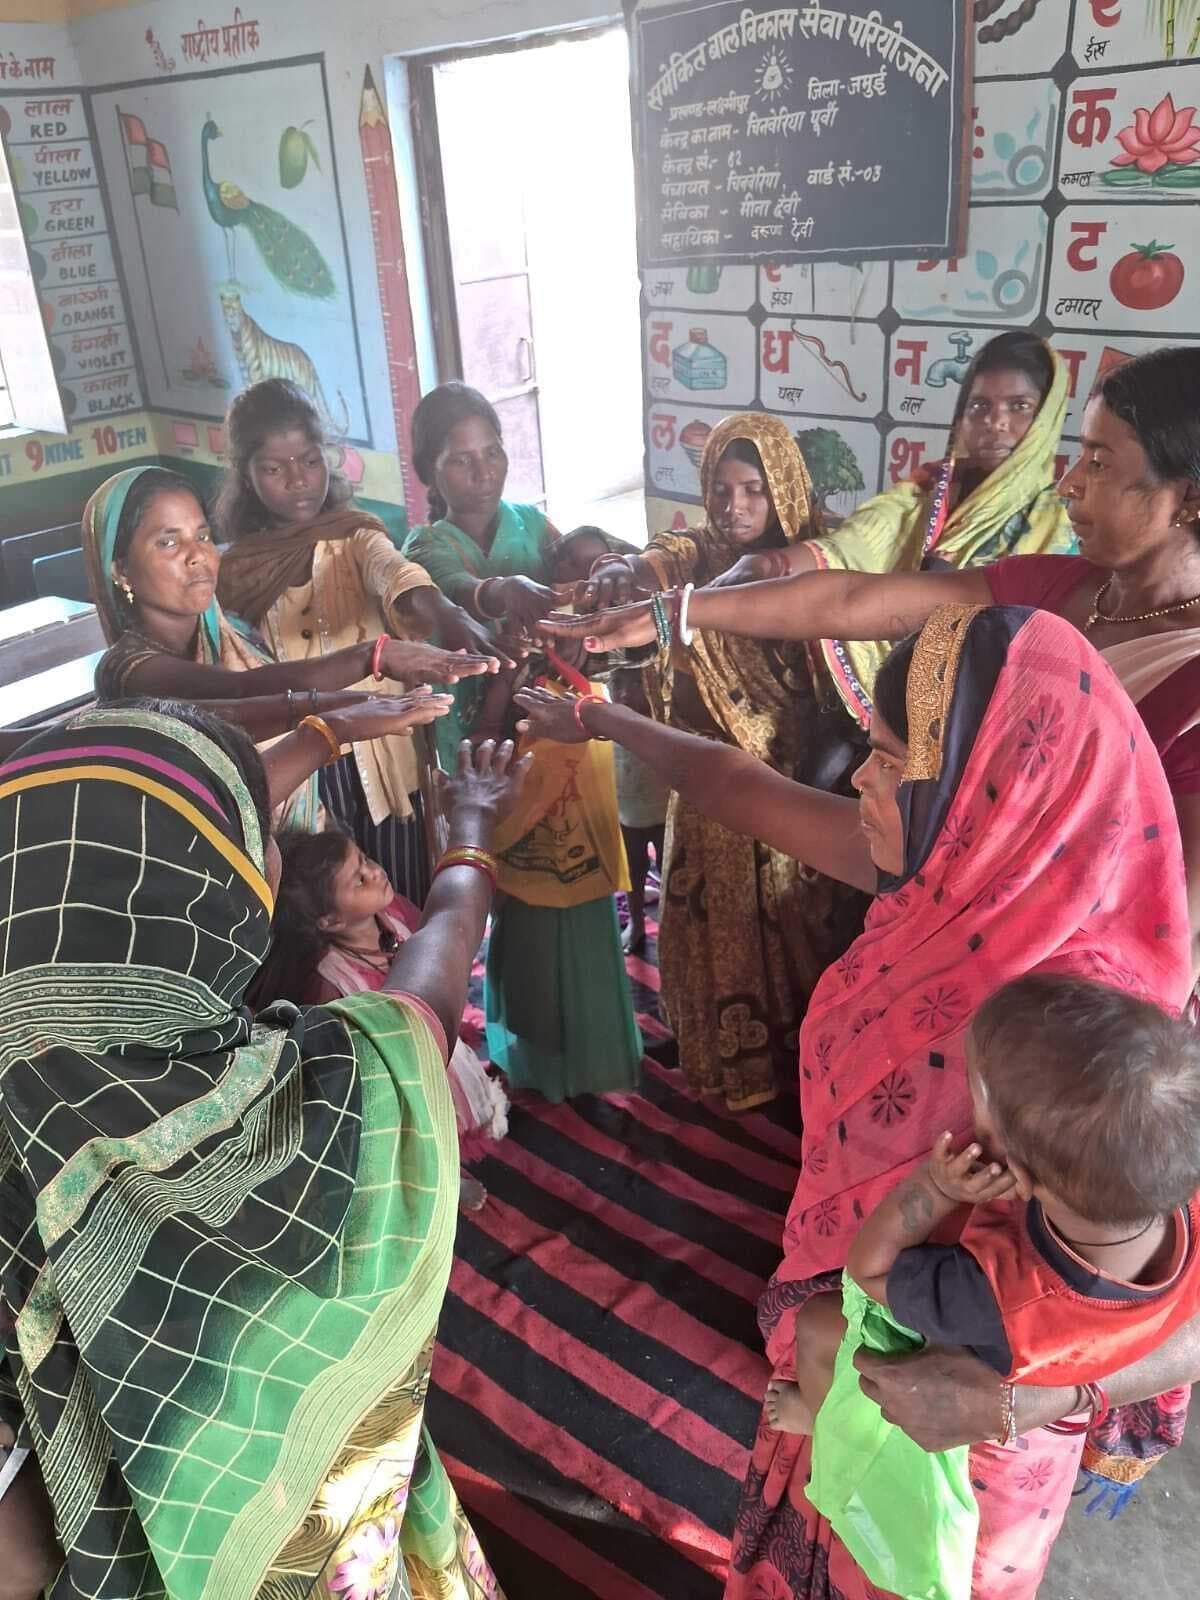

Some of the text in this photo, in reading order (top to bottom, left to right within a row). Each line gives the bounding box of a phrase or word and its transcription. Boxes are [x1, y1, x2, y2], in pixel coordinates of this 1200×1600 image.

[708, 23, 739, 60] बाल
[740, 8, 798, 47] विकास
[800, 0, 847, 40] सेवा
[848, 10, 949, 98] परियोजना
[24, 98, 75, 117] लाल
[1067, 88, 1117, 148] क
[30, 122, 68, 138] RED
[33, 167, 91, 186] YELLOW
[1061, 171, 1095, 186] कमल
[44, 216, 95, 232] GREEN
[1067, 222, 1107, 272] ट
[59, 264, 97, 280] BLUE
[62, 306, 115, 326] ORANGE
[1055, 298, 1102, 320] टमाटर
[78, 351, 126, 369] VIOLET
[895, 340, 927, 385] न
[88, 392, 135, 413] BLACK
[651, 414, 677, 450] ल
[25, 440, 43, 472] 9
[45, 438, 84, 465] NINE
[90, 425, 117, 456] 10
[117, 426, 147, 449] TEN
